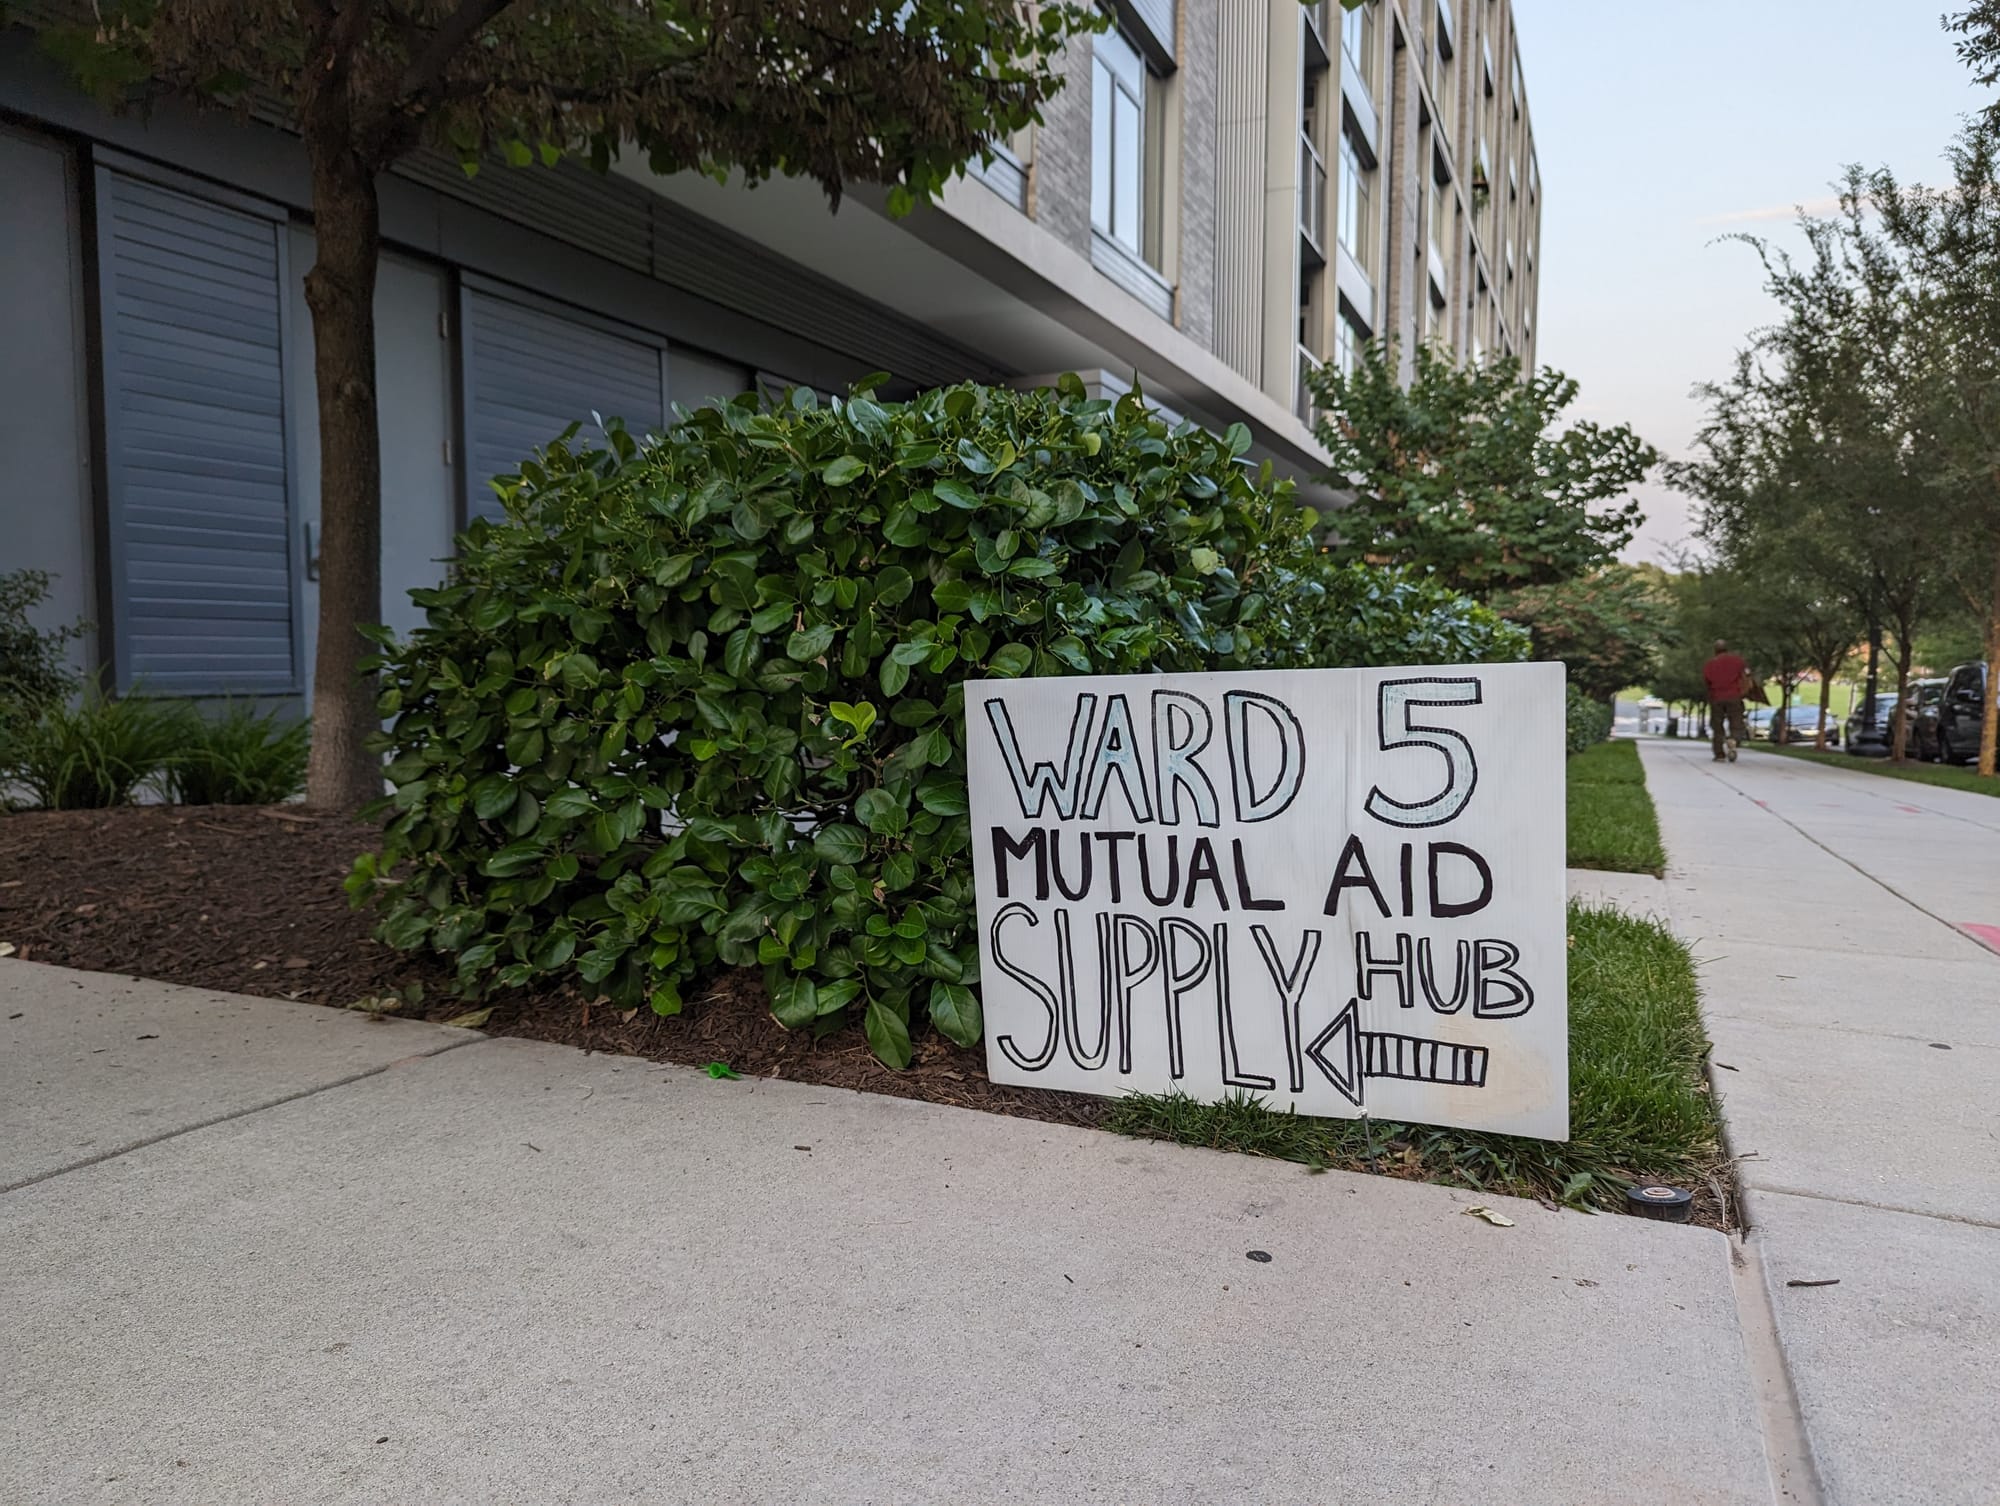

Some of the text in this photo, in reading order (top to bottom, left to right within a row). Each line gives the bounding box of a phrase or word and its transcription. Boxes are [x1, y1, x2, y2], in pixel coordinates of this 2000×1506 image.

[985, 677, 1483, 829] WARD 5
[991, 827, 1493, 918] MUTUAL AID
[990, 901, 1535, 1093] SUPPLY HUB
